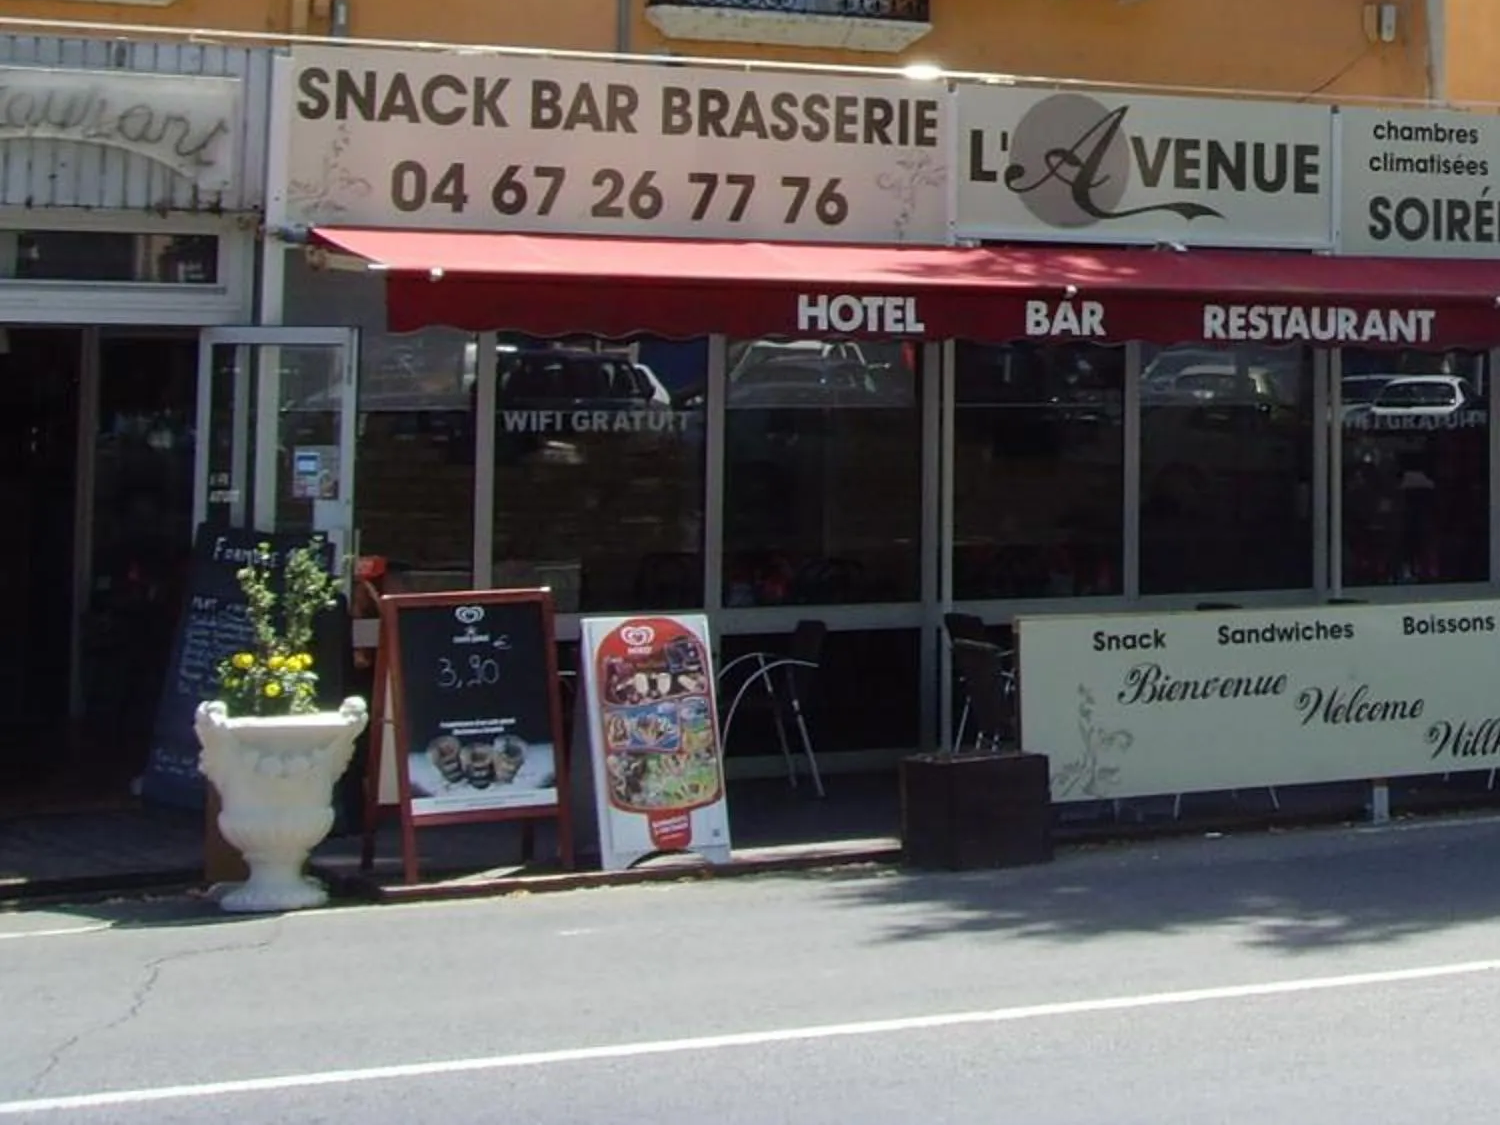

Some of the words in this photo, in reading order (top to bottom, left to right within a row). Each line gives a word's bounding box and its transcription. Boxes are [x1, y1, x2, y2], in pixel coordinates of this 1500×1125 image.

[297, 66, 510, 128] SNACK
[530, 80, 638, 134] BAR
[661, 87, 939, 146] BRASSERIE
[1373, 120, 1479, 144] chambres
[969, 104, 1320, 220] L'AVENUE
[1368, 154, 1489, 176] climatisées
[391, 160, 470, 214] 04
[491, 166, 566, 216] 67
[591, 169, 665, 220] 26
[688, 173, 757, 222] 77
[781, 176, 849, 226] 76
[798, 295, 924, 332] HOTEL
[1025, 300, 1106, 336] BAR
[1203, 305, 1434, 342] RESTAURANT
[503, 410, 563, 432] WIFI
[570, 410, 690, 432] GRATUIT
[1092, 629, 1166, 652] Snack
[1217, 620, 1355, 646] Sandwiches
[1402, 614, 1496, 637] Boissons
[1117, 661, 1288, 705] Bienvenue
[1296, 684, 1426, 726] Welcome
